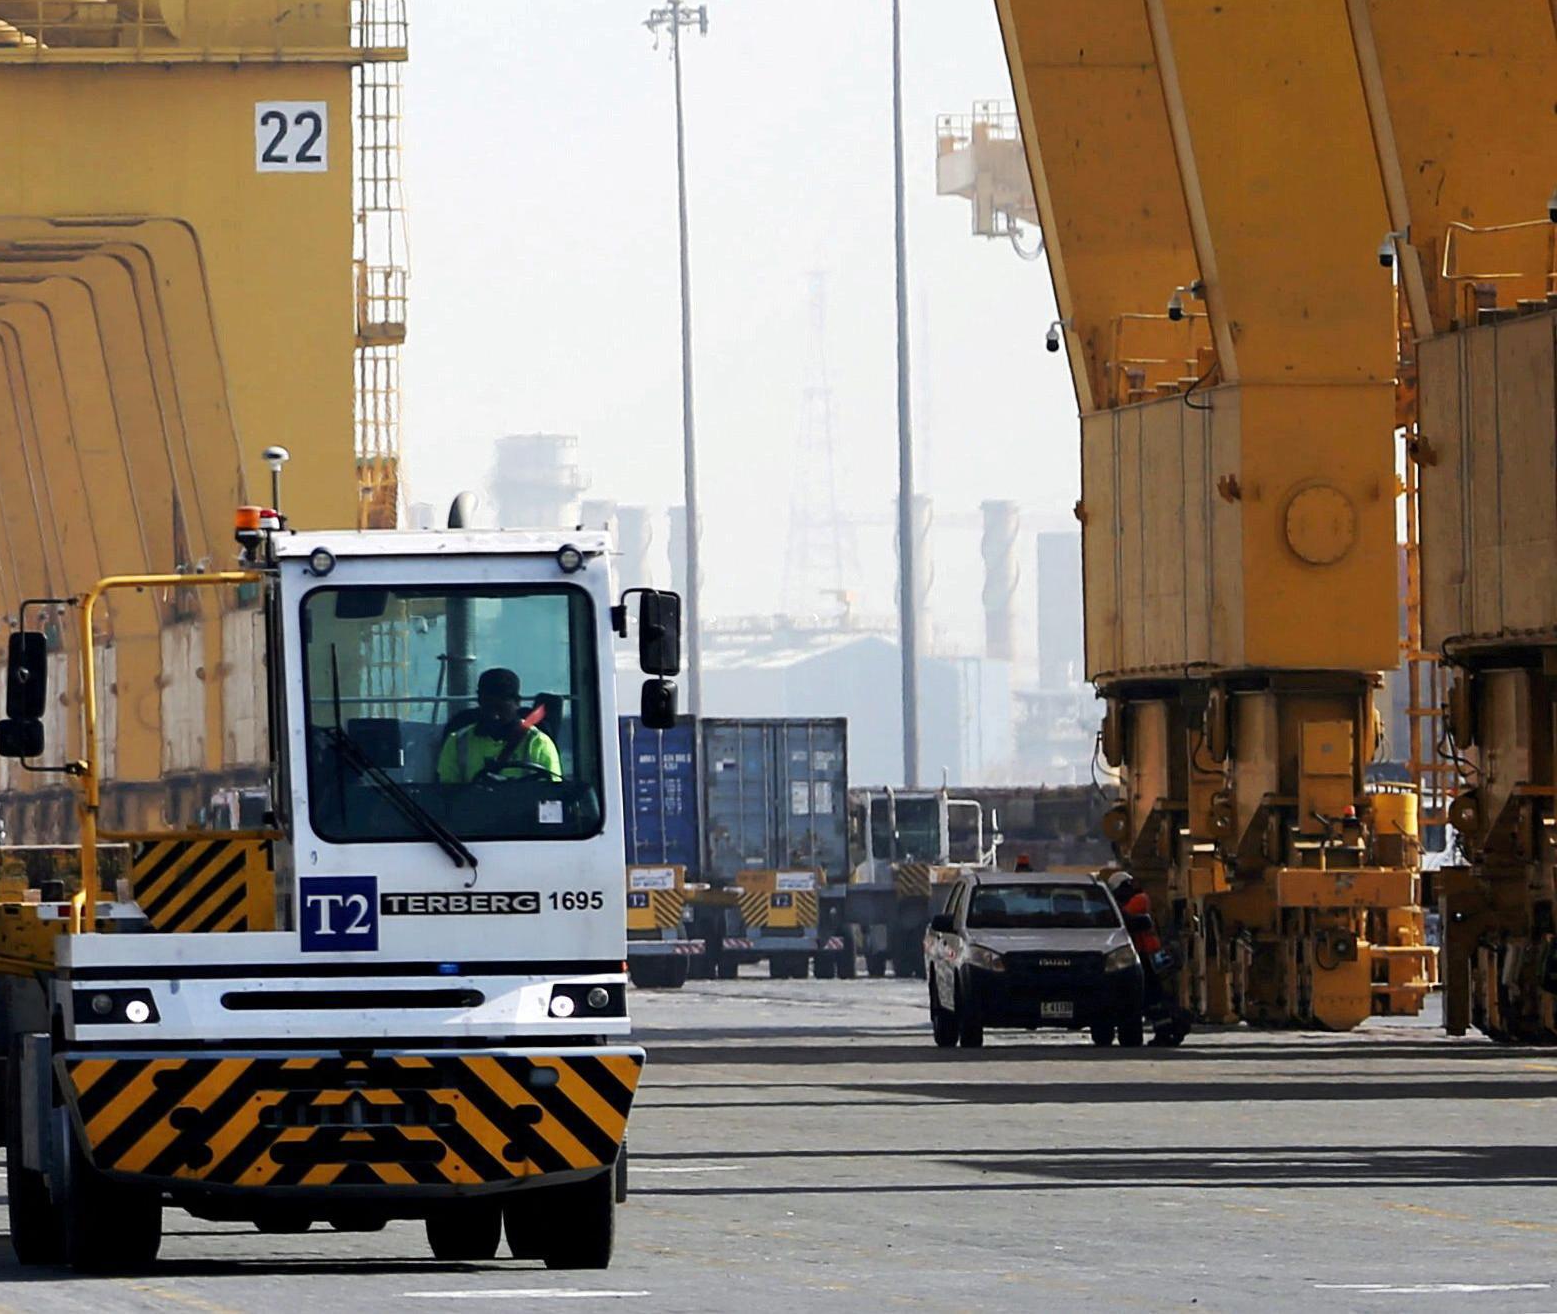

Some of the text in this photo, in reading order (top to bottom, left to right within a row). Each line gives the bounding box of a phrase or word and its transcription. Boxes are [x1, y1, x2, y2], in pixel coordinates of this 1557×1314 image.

[260, 111, 323, 164] 22
[306, 892, 603, 935] T2 TERBERG 1695
